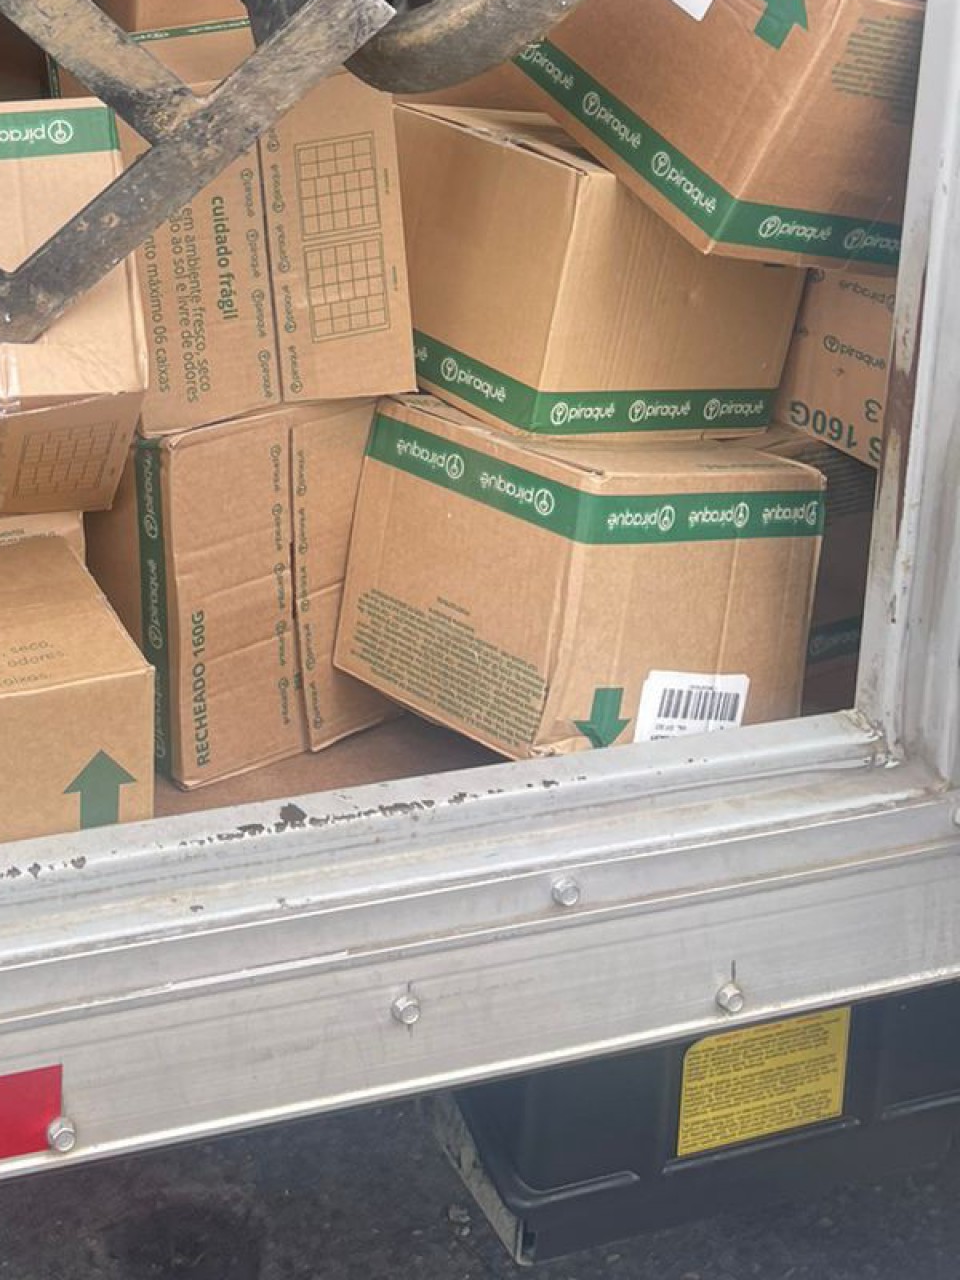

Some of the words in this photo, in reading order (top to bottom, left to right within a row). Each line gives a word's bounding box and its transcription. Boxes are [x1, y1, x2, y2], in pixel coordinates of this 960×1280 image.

[532, 49, 575, 90] piraquê
[597, 104, 642, 149] piraquê
[667, 167, 717, 215] piraquê
[171, 236, 183, 256] ao
[211, 195, 230, 268] cuidado
[779, 222, 833, 242] piraquê
[862, 233, 902, 252] piraq
[172, 257, 185, 281] sol
[186, 235, 202, 304] ambiente
[146, 264, 162, 323] máximo
[176, 282, 187, 292] e
[217, 270, 239, 320] frágil
[177, 295, 190, 327] livre
[152, 326, 167, 346] 06
[180, 329, 193, 349] de
[191, 305, 206, 357] fresco,
[155, 350, 171, 394] caixas
[839, 342, 887, 370] piraquê
[182, 351, 199, 404] odores
[197, 358, 211, 393] seco
[456, 368, 507, 404] piraquê
[567, 400, 616, 424] piraquê
[646, 400, 693, 421] piraquê
[719, 399, 764, 420] piraquê
[790, 400, 858, 450] 160G
[396, 438, 448, 471] piraquê
[479, 470, 537, 504] piraquê
[607, 510, 659, 532] piraquê
[687, 508, 736, 530] piraquê
[763, 506, 808, 527] piraquê
[191, 609, 206, 659] 160G
[191, 662, 211, 768] RECHEADO
